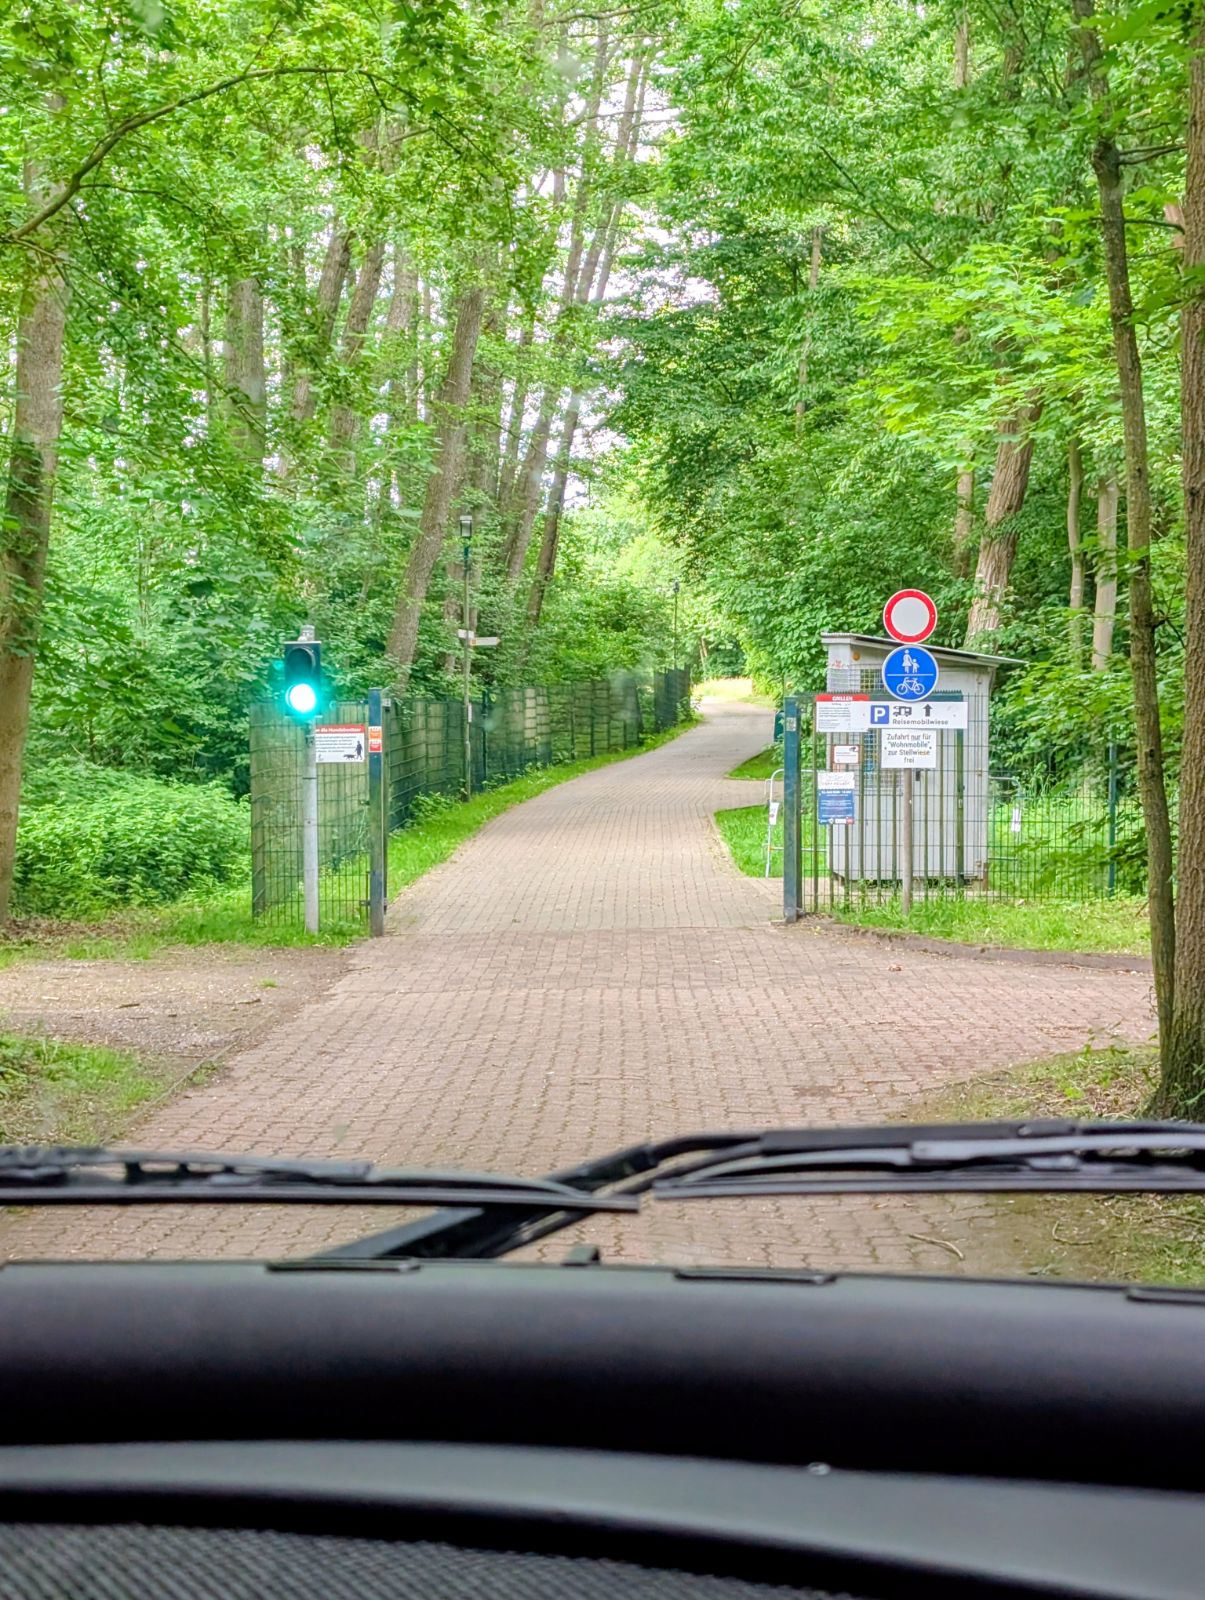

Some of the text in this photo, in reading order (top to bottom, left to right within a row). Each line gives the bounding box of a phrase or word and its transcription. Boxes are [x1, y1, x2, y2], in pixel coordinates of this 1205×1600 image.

[874, 707, 886, 722] P
[886, 733, 910, 741] Zufahrt
[922, 733, 932, 741] für
